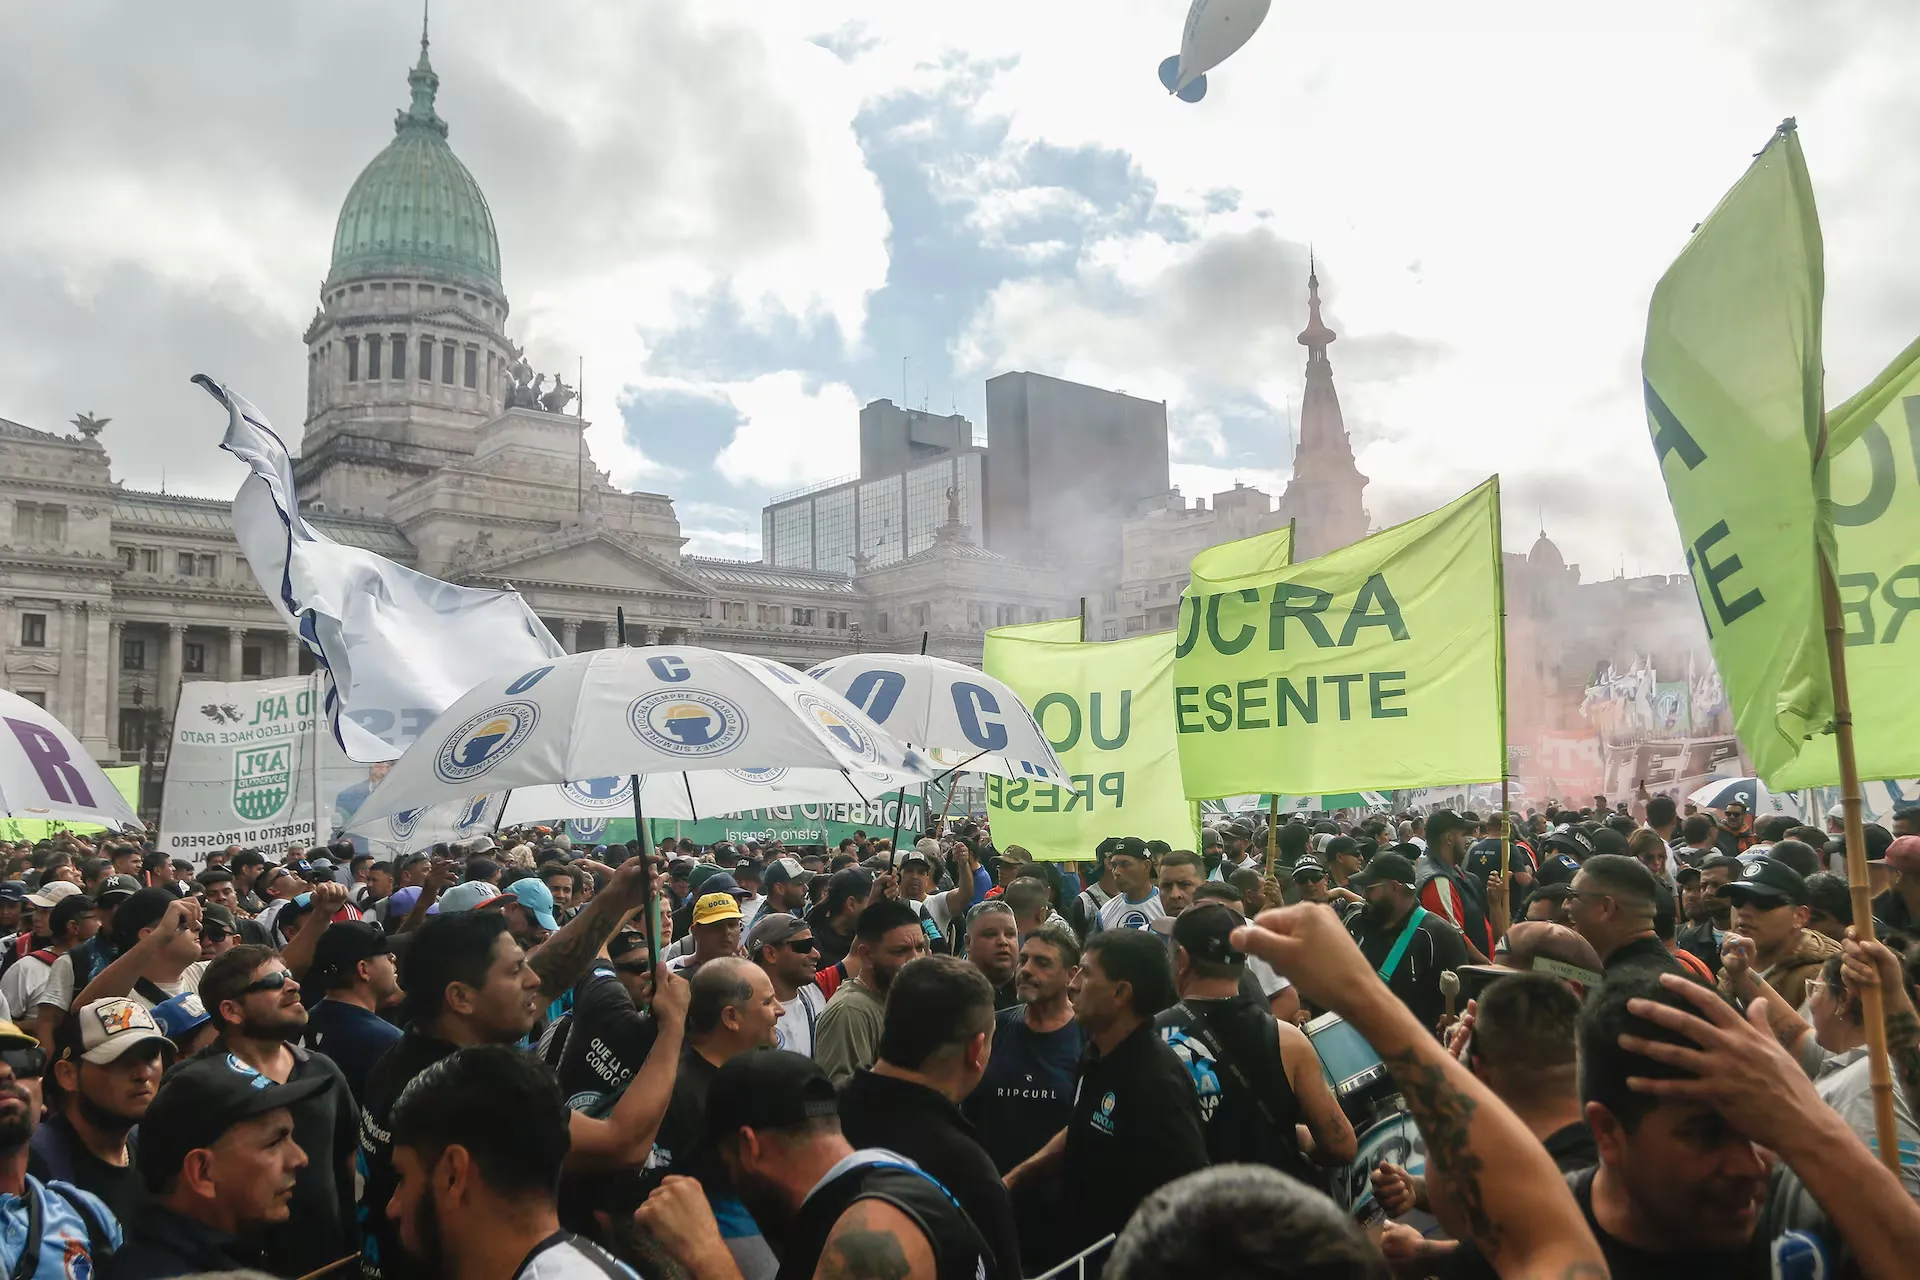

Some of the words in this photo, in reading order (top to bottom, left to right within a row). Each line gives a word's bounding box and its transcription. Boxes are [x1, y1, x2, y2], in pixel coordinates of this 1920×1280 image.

[646, 693, 693, 707] SIEMPRE
[697, 695, 737, 728] GERARDO
[637, 704, 649, 730] UOCRA
[446, 723, 474, 753] UOCRA
[644, 729, 692, 753] SIEMPRE
[694, 726, 737, 753] MARTINEZ
[2, 716, 98, 809] R
[708, 899, 730, 908] UOCRA
[585, 1051, 613, 1081] COMO
[590, 1037, 613, 1062] QUE
[607, 1056, 621, 1073] LA
[620, 1068, 633, 1079] C
